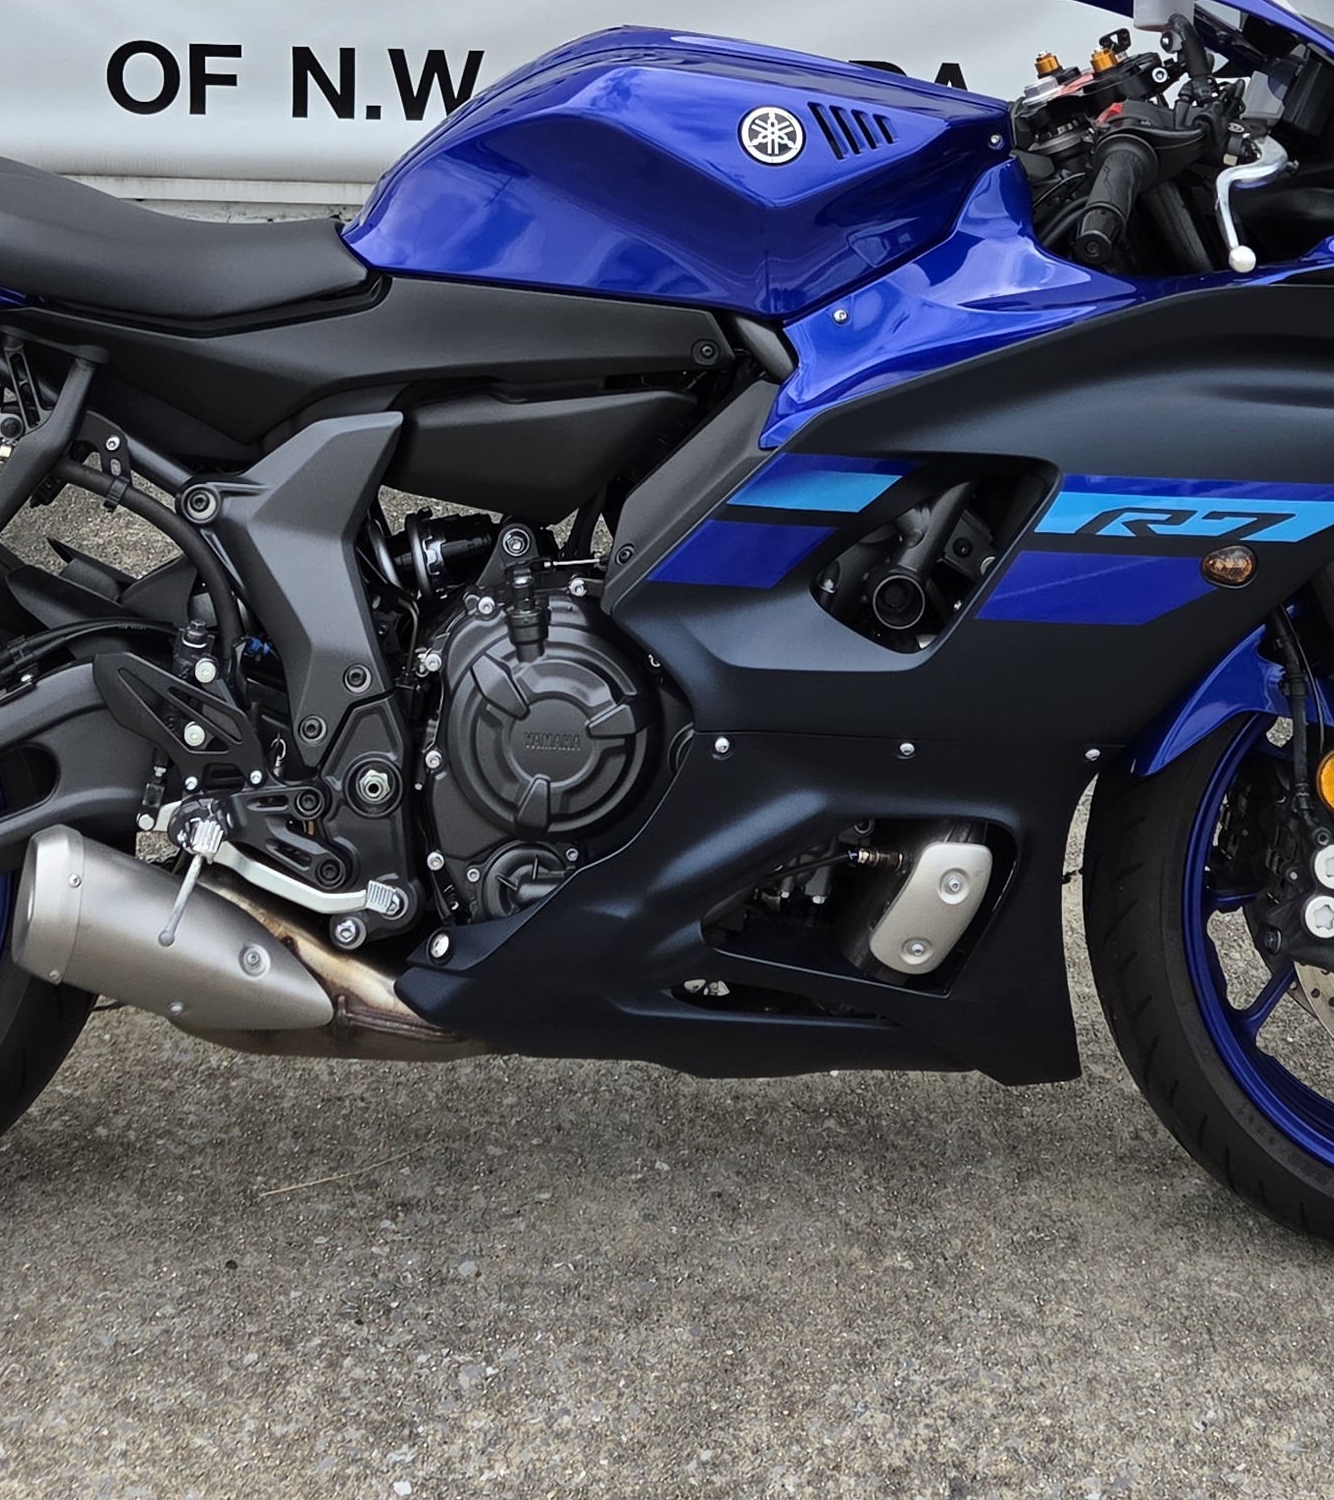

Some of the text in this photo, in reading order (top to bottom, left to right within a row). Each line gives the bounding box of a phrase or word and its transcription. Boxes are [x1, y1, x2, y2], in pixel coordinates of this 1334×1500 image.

[107, 40, 242, 114] OF
[1075, 507, 1296, 540] R7
[524, 732, 581, 751] YAMAHA
